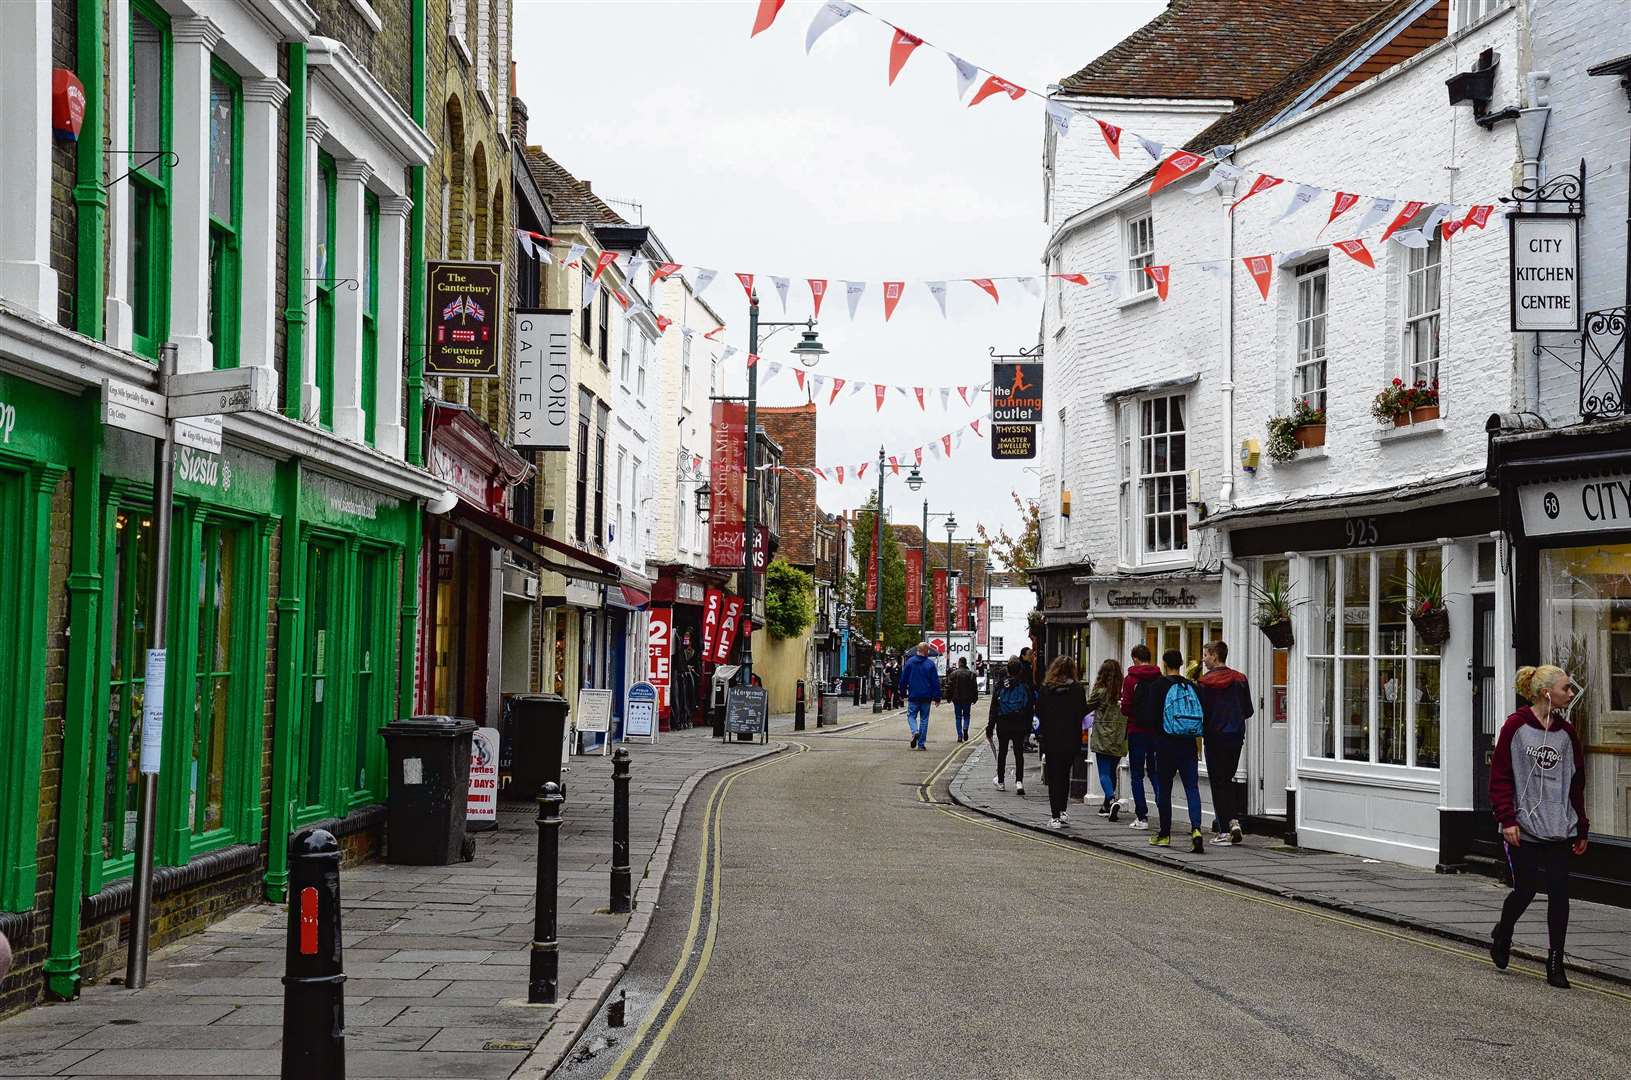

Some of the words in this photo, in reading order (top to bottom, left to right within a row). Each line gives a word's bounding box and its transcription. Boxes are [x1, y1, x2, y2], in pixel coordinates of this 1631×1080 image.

[1529, 238, 1562, 253] CITY
[447, 273, 466, 282] The
[1516, 267, 1574, 281] KITCHEN
[437, 282, 492, 295] Canterbury
[1521, 295, 1571, 309] CENTRE
[441, 345, 484, 355] Souvenir
[456, 356, 481, 367] Shop
[519, 320, 533, 439] GALLERY
[548, 333, 567, 427] LILFORD
[994, 386, 1011, 396] the
[995, 398, 1042, 411] running
[994, 407, 1033, 419] outlet
[997, 425, 1032, 433] THYSSEN
[715, 422, 729, 452] Mile
[179, 446, 218, 487] Siesta
[1545, 497, 1558, 514] 58
[1581, 480, 1631, 521] CITY
[713, 502, 728, 528] The
[1345, 517, 1379, 546] 925
[702, 595, 718, 656] SALE
[717, 602, 740, 659] SALE
[950, 642, 970, 653] dpd
[1526, 746, 1546, 758] Hard
[474, 779, 495, 788] DAYS
